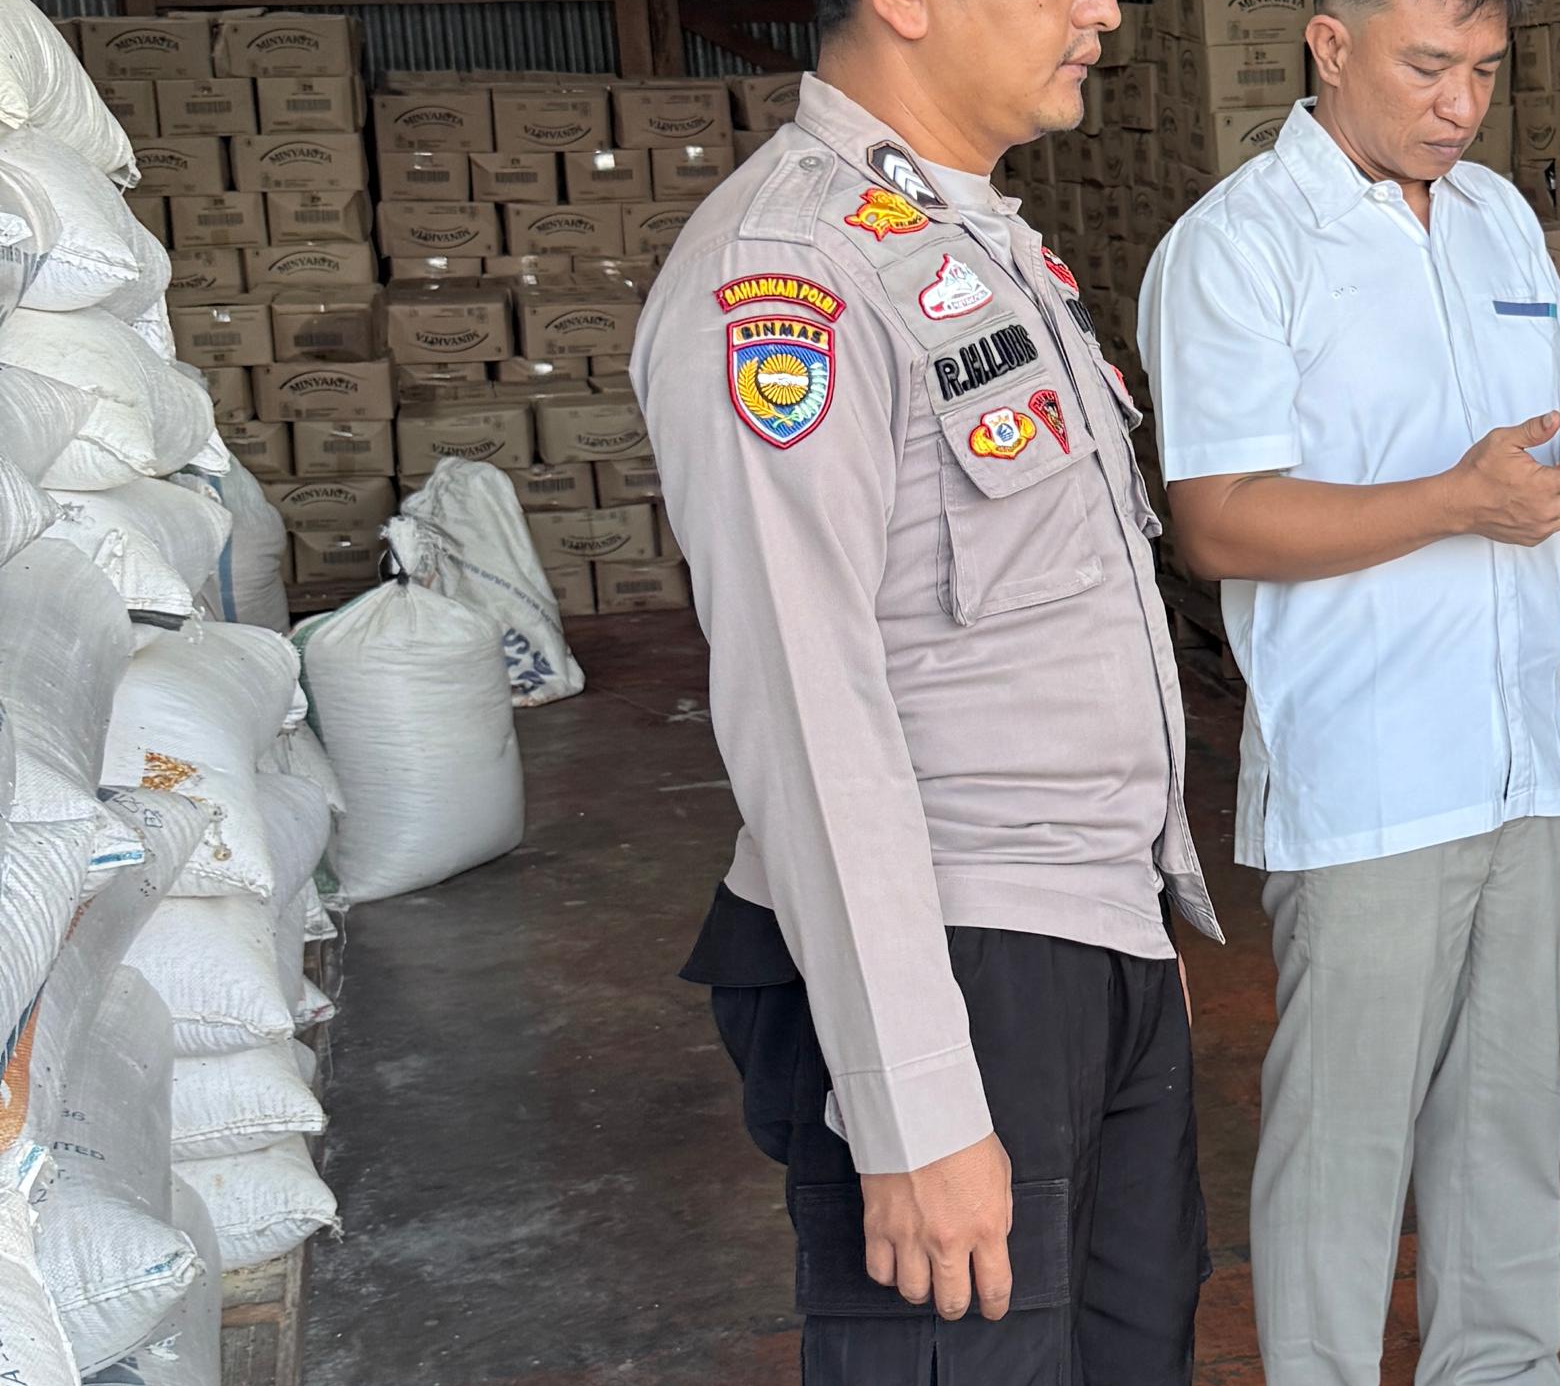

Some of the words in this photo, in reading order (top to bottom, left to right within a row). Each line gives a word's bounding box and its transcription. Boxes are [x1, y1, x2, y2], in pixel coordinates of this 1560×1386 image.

[724, 277, 798, 306] BAHARKAM
[740, 322, 823, 344] BINMAS
[289, 376, 358, 395] MINYAKITA
[290, 488, 357, 506] MINYAKITA
